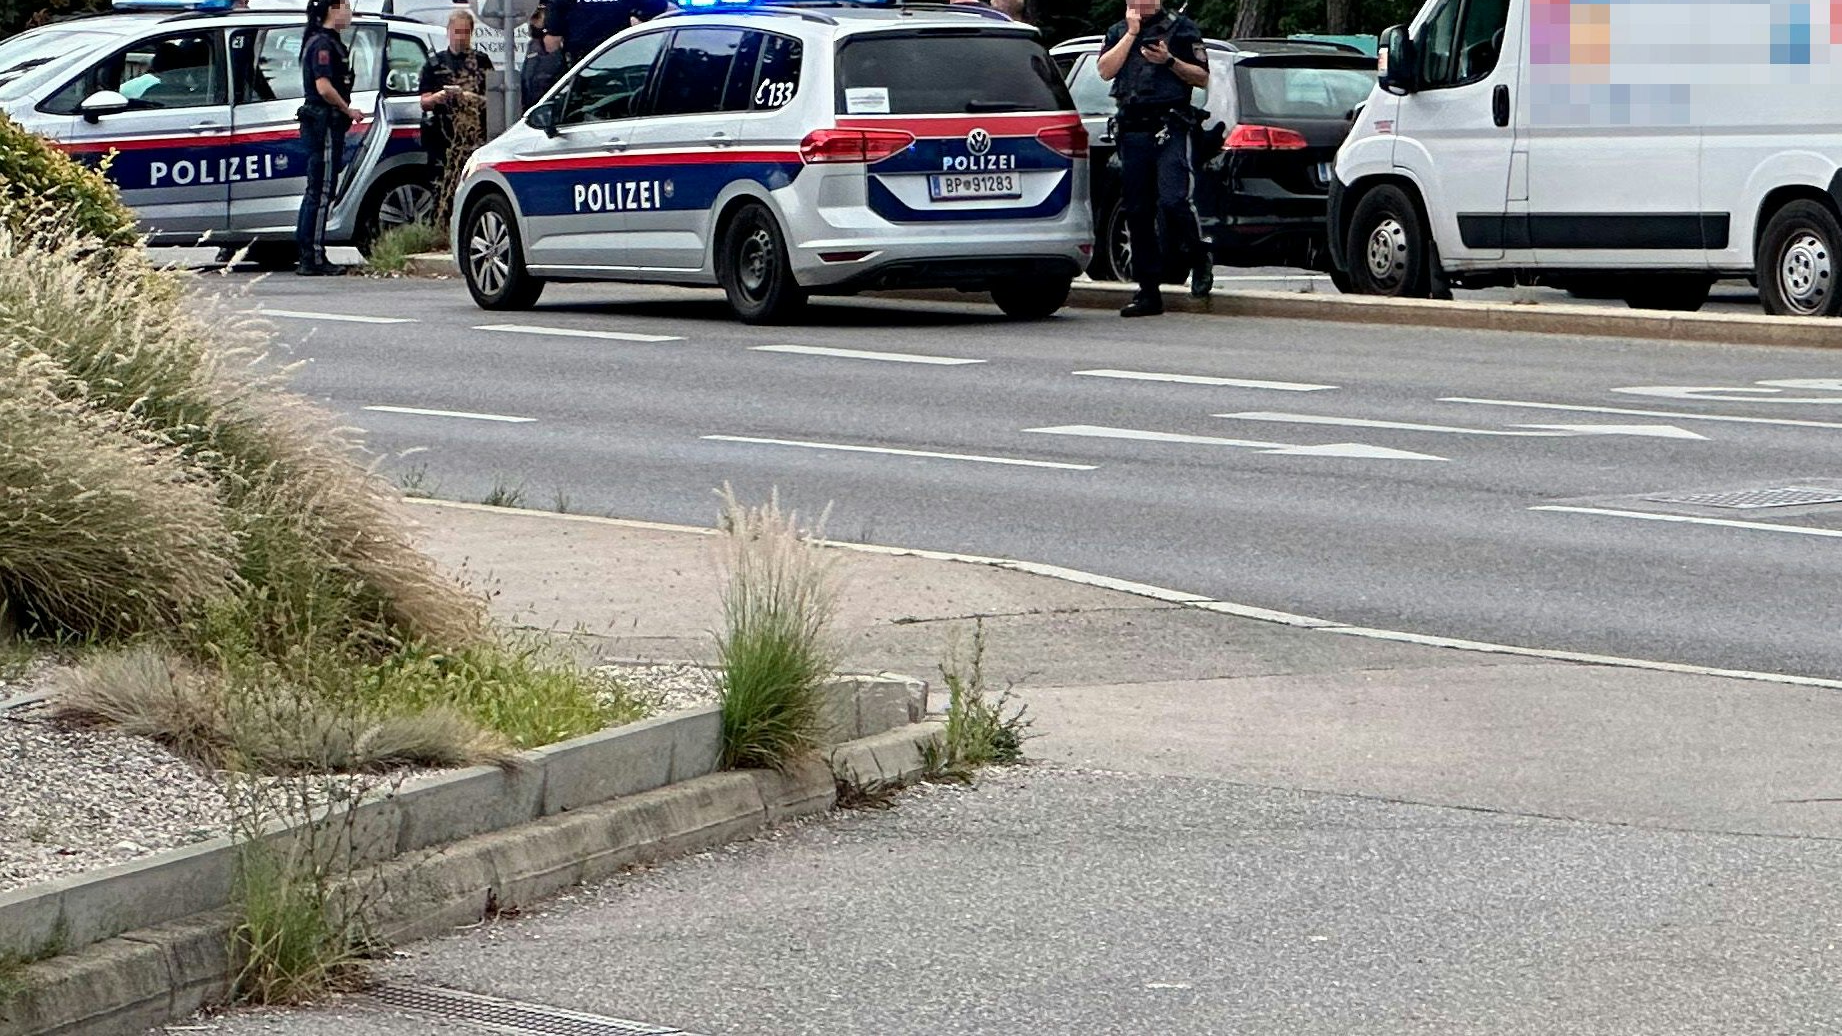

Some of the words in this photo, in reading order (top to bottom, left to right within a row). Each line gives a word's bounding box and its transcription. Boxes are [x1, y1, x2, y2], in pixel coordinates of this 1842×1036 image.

[768, 81, 794, 106] 133
[150, 153, 273, 186] POLIZEI
[942, 153, 1015, 171] POLIZEI
[574, 180, 661, 212] POLIZEI
[945, 178, 962, 194] BP
[972, 175, 1013, 193] 91283
